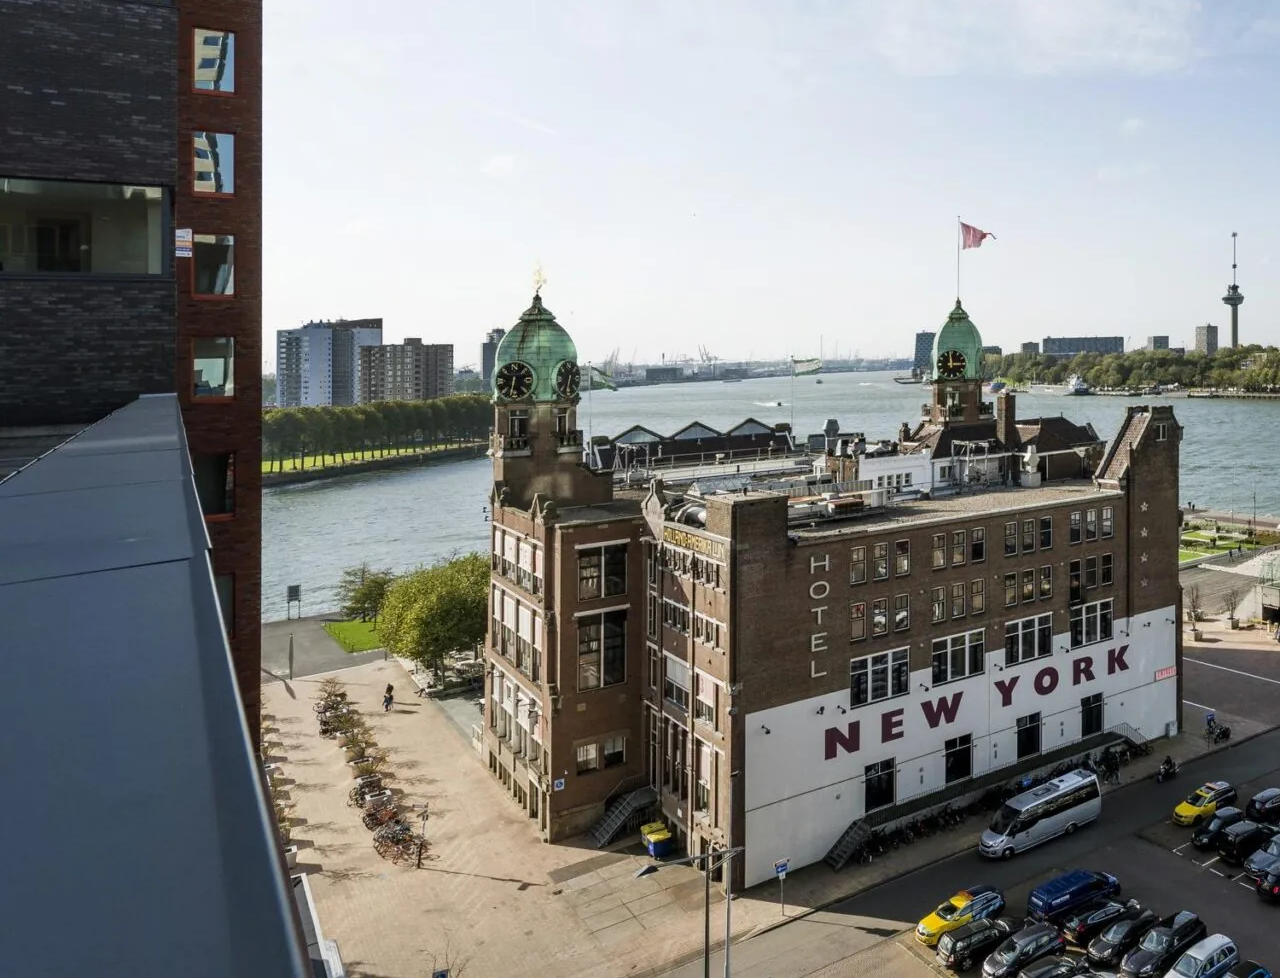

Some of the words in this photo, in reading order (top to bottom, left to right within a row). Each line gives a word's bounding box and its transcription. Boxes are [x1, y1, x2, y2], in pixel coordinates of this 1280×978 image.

[809, 554, 830, 678] HOTEL
[824, 691, 964, 761] NEW
[994, 644, 1130, 708] YORK
